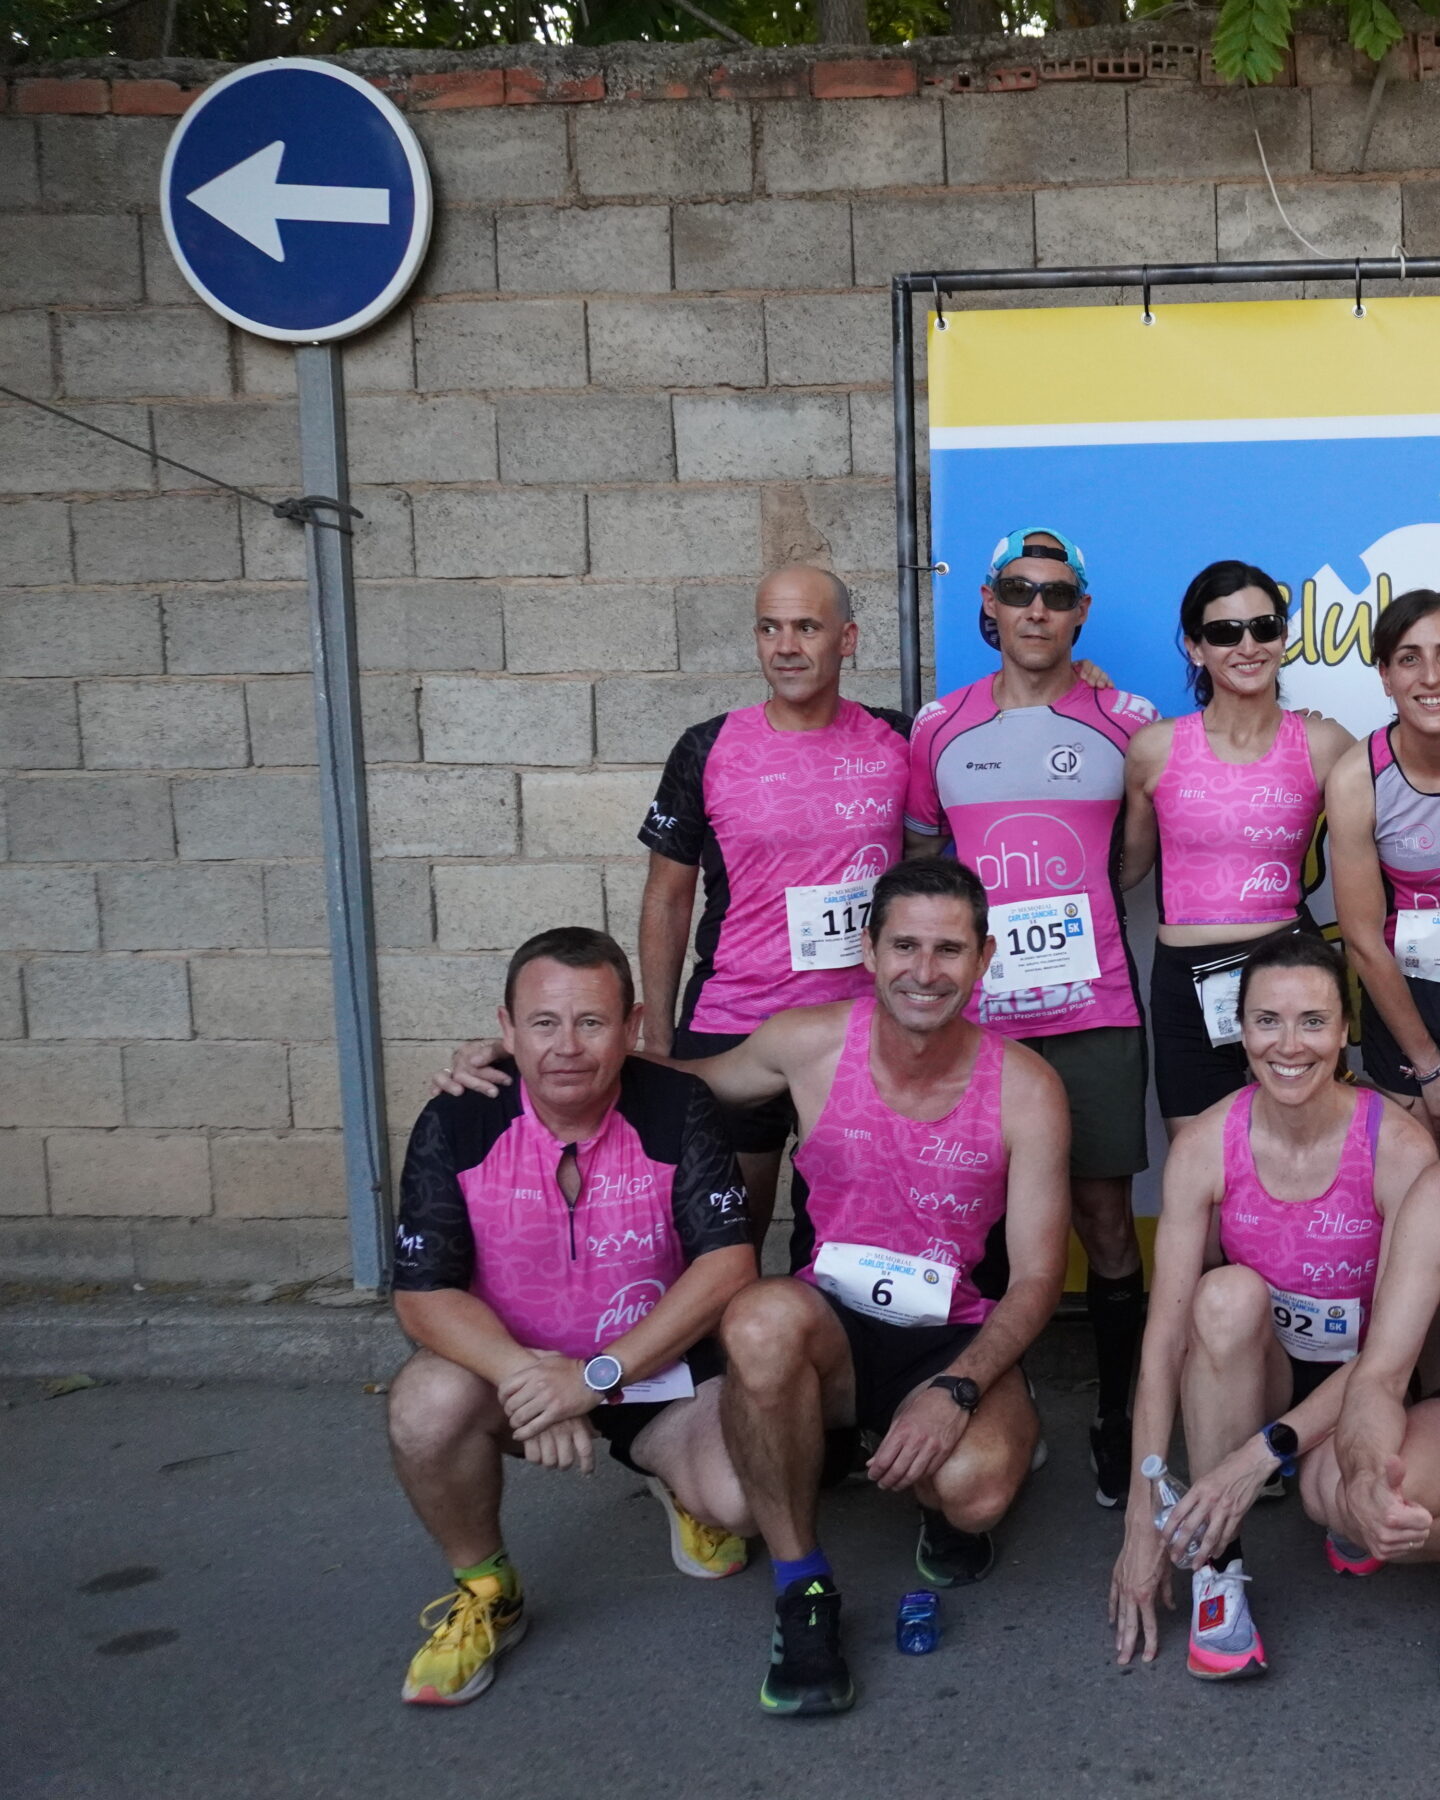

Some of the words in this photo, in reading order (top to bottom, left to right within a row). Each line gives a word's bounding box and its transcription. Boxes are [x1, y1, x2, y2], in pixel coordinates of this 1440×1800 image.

[974, 761, 1002, 771] TACTIC
[1179, 788, 1206, 799] TACTIC
[822, 901, 872, 936] 117
[1067, 923, 1080, 934] 5K
[1007, 922, 1067, 956] 105
[858, 1257, 885, 1271] CARLOS
[873, 1252, 912, 1267] MEMORIAL
[871, 1278, 894, 1306] 6
[1273, 1306, 1313, 1338] 92
[1328, 1322, 1343, 1332] 5K
